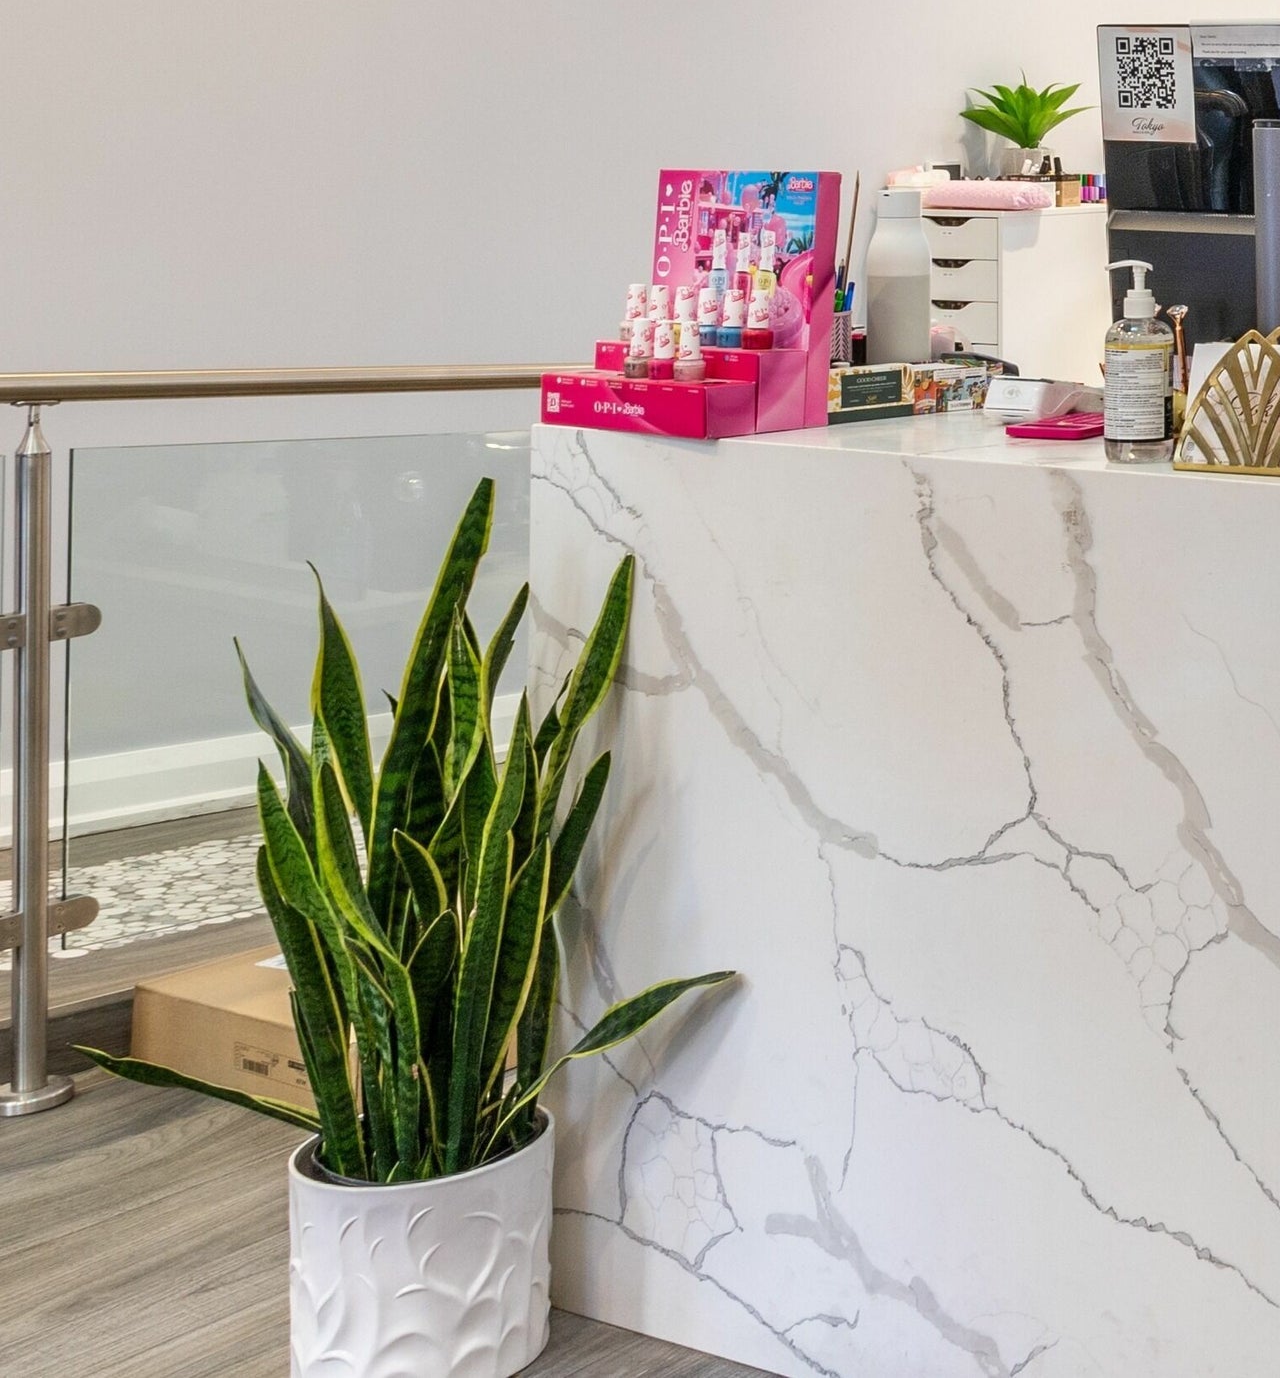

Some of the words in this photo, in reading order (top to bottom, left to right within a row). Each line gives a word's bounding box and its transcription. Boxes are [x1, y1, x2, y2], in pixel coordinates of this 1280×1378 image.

[1131, 116, 1165, 136] Tokyo
[786, 176, 814, 192] Barbie
[673, 179, 693, 253] Barbie
